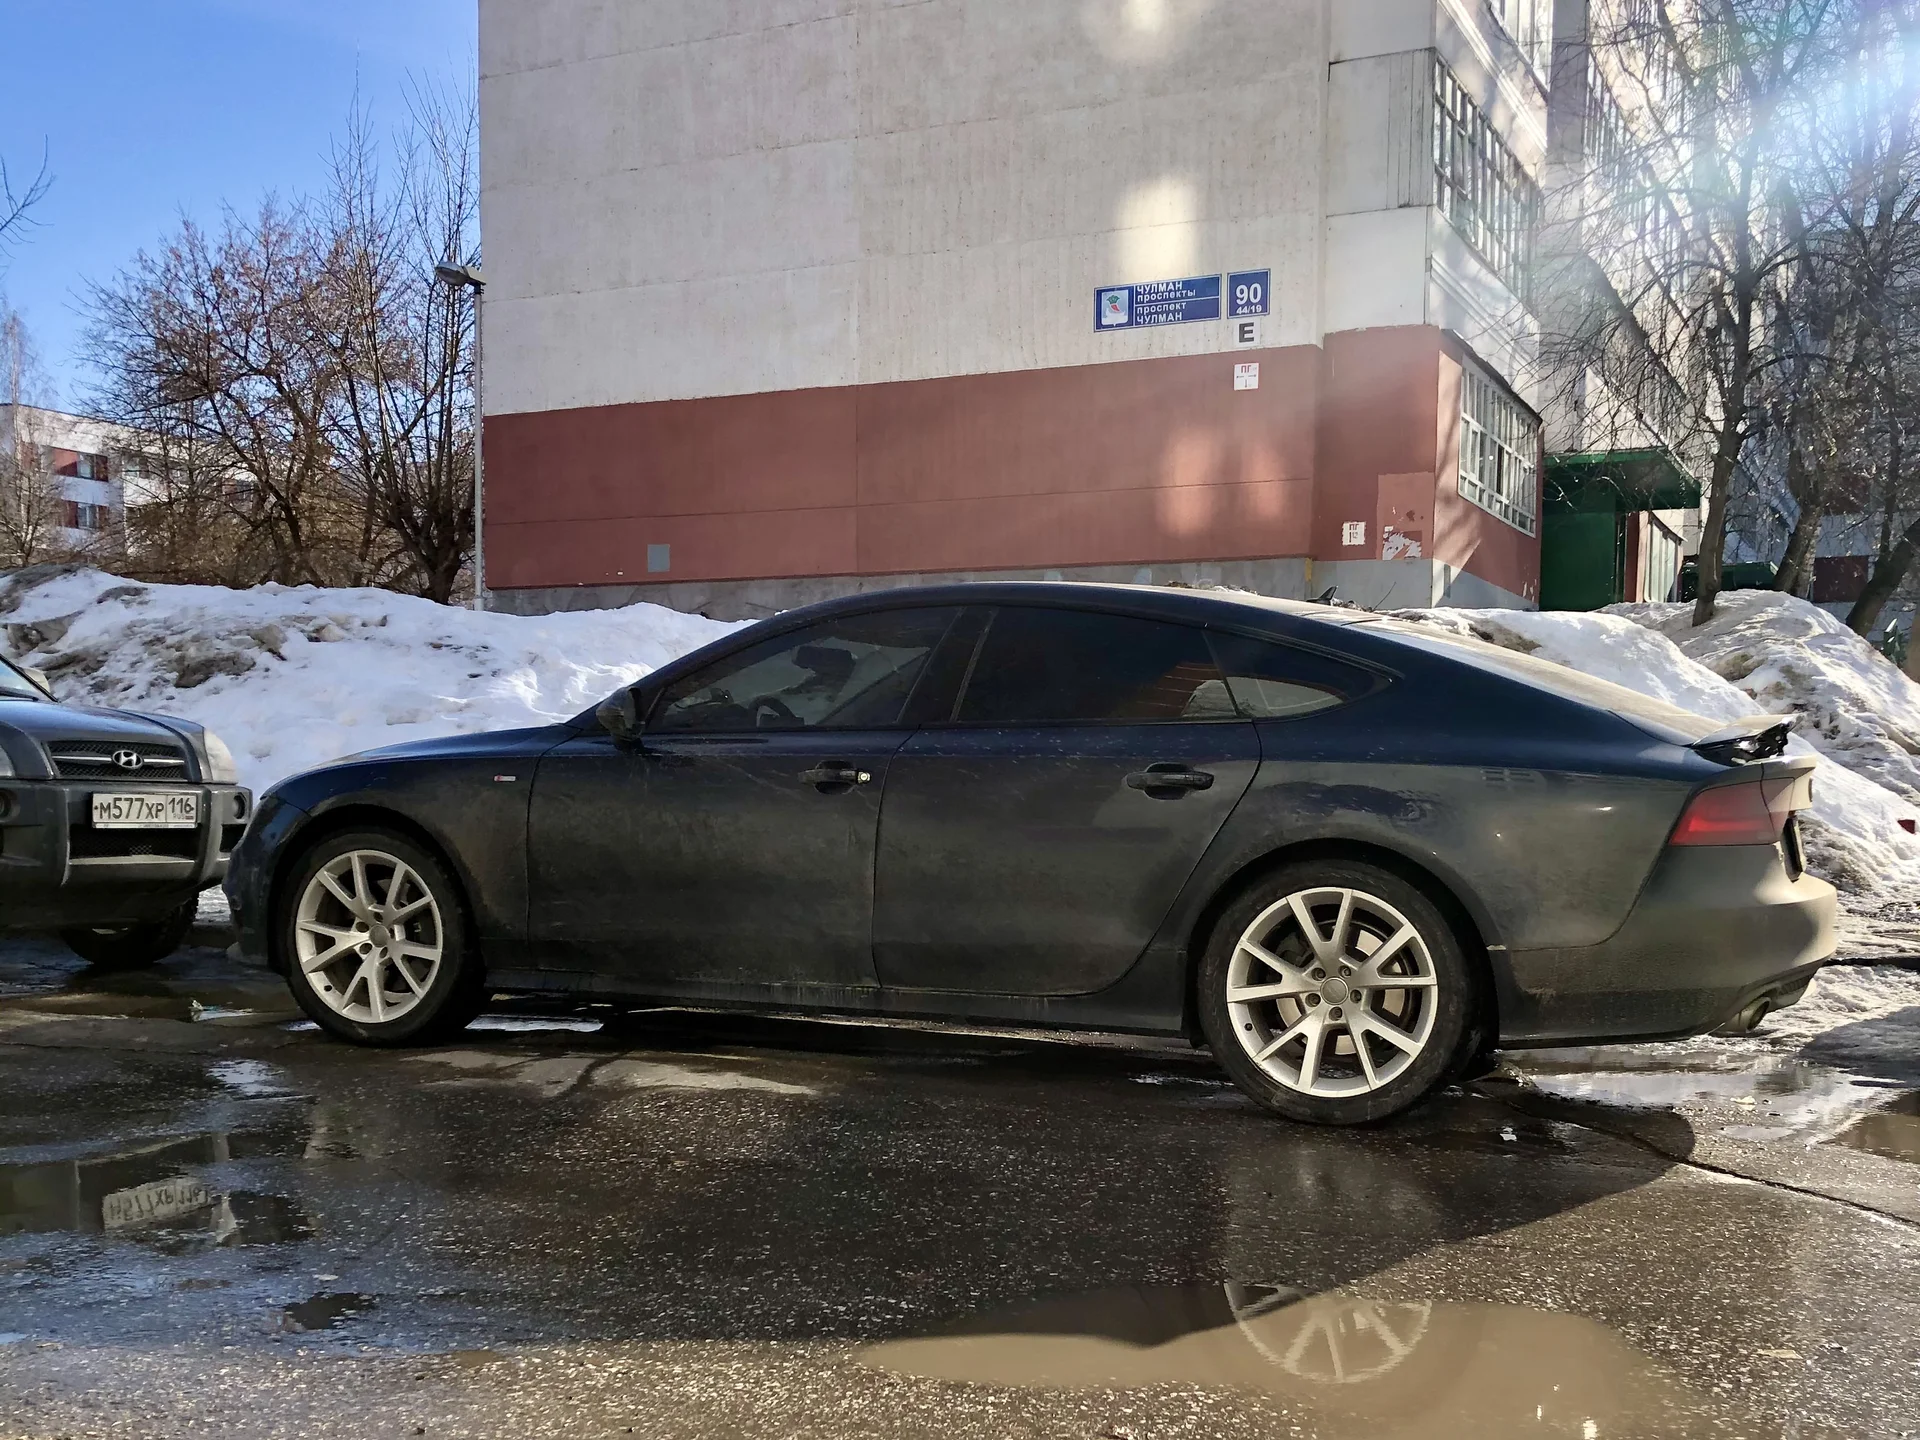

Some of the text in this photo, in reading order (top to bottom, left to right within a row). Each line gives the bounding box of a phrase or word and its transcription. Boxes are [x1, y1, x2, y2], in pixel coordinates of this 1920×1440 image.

[1137, 281, 1183, 294] ЧУЛМАН
[1235, 283, 1262, 305] 90
[1137, 289, 1196, 303] проспекты
[1136, 302, 1187, 315] проспект
[1236, 304, 1262, 314] 44/19
[1136, 312, 1183, 325] ЧУЛМАН
[168, 797, 192, 814] 116
